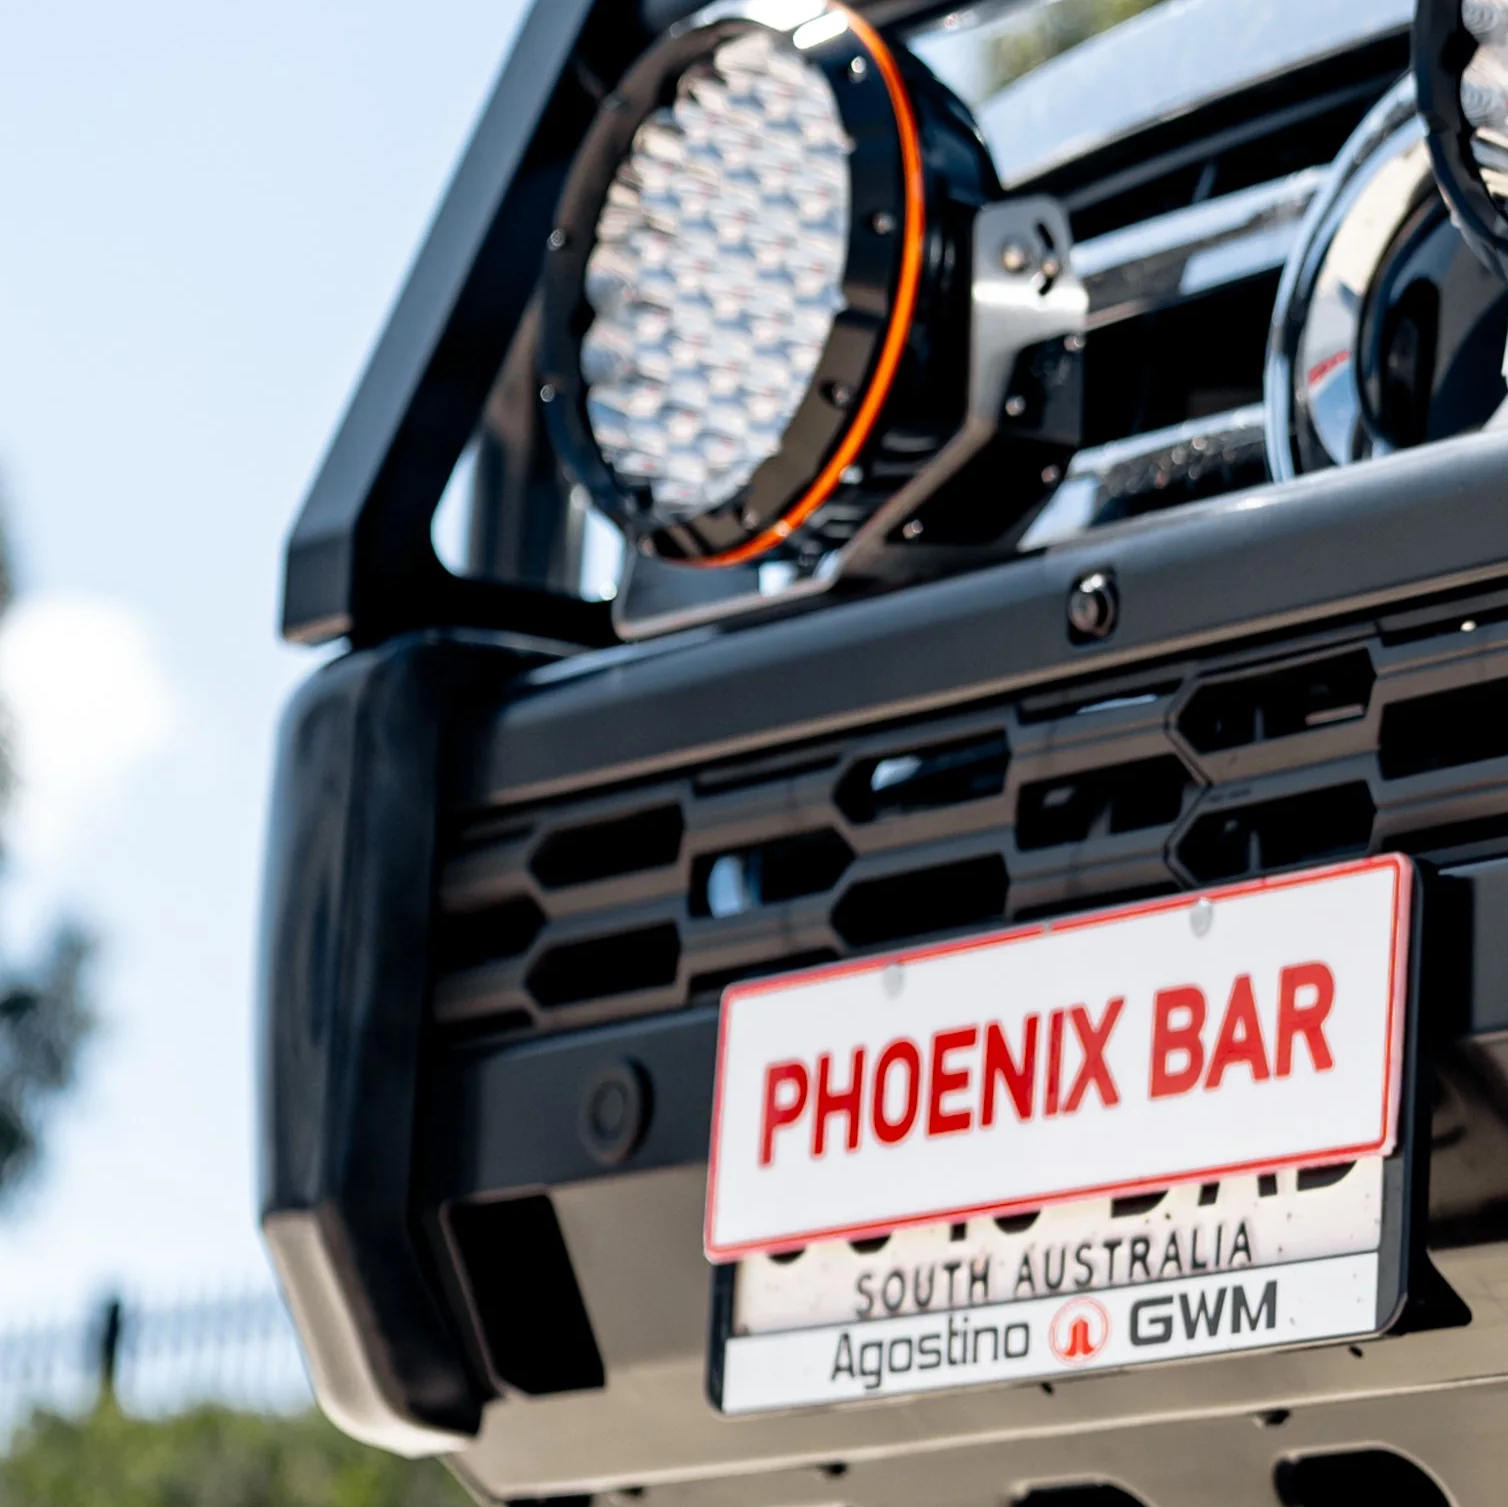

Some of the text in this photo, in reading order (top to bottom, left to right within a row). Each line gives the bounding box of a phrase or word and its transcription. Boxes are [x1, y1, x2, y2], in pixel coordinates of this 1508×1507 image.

[758, 961, 1336, 1167] PHOENIX BAR
[854, 1218, 1254, 1318] SOUTH AUSTRALIA
[830, 1280, 1279, 1390] Agostino GWM
